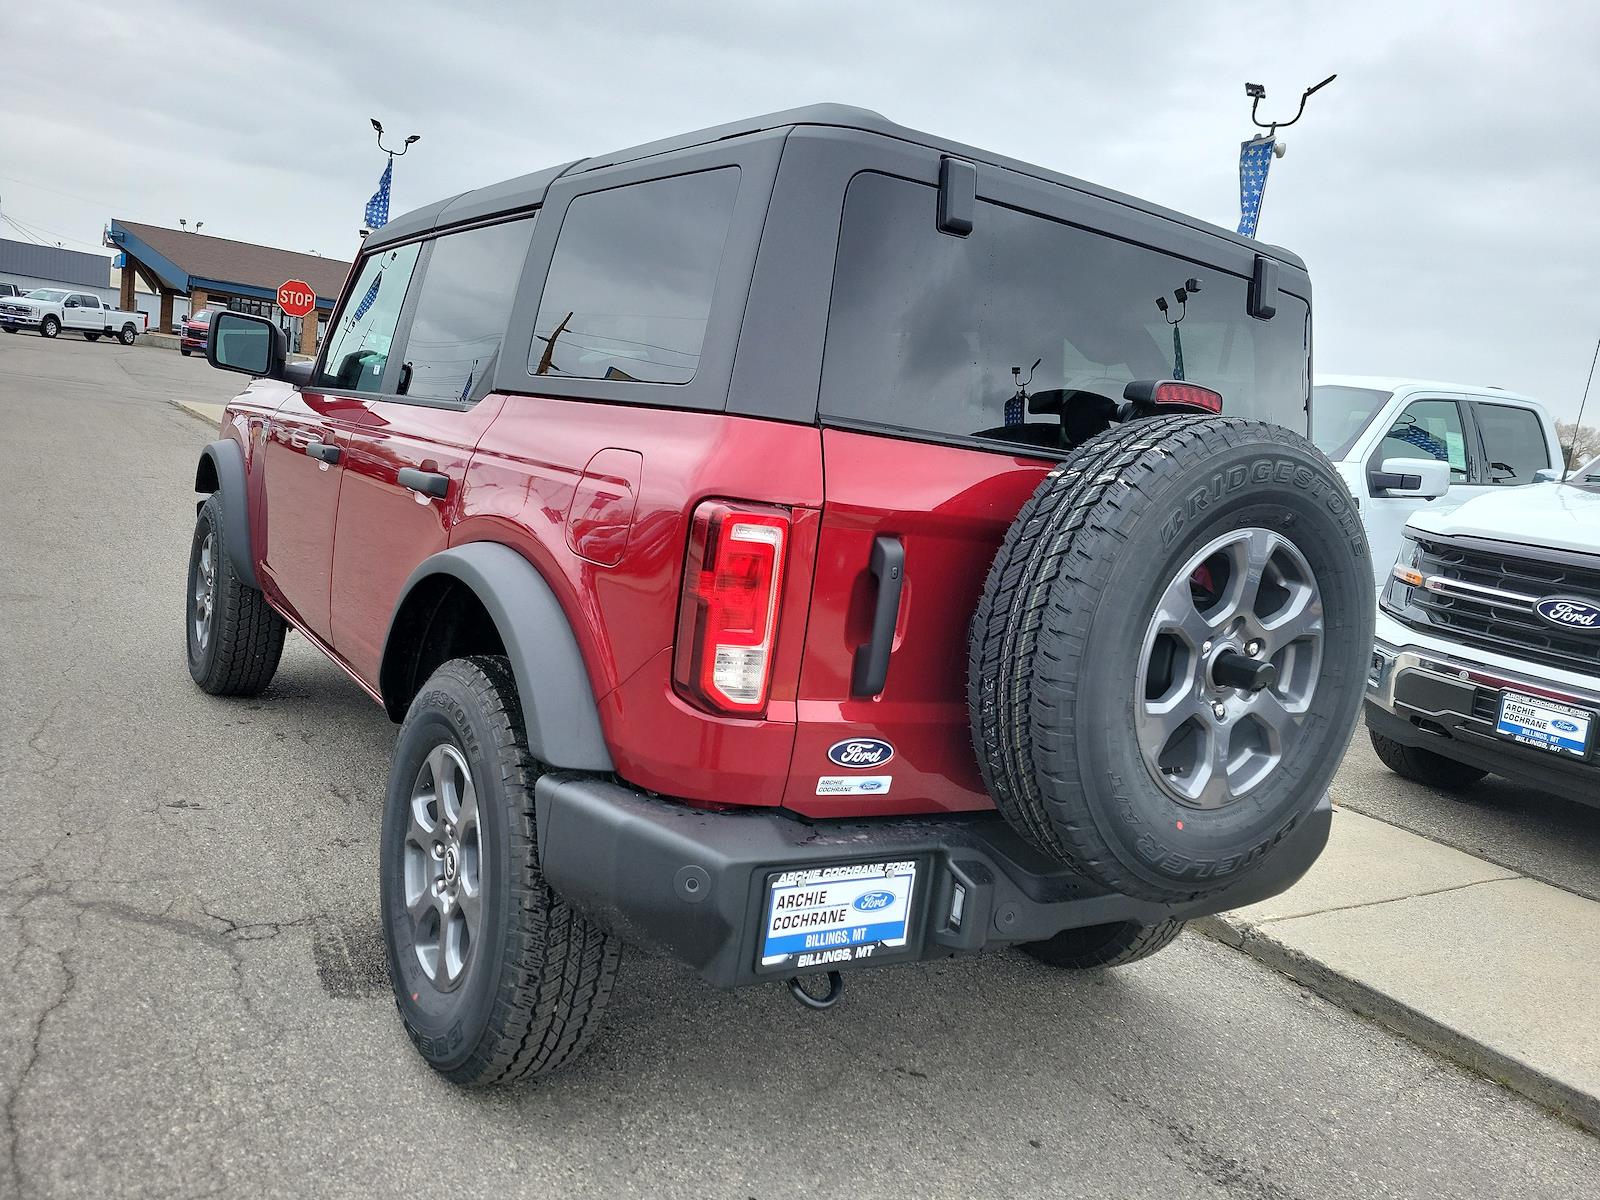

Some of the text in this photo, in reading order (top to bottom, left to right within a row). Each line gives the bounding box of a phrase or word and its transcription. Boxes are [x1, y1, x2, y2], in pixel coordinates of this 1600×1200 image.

[280, 290, 313, 307] STOP
[1160, 459, 1366, 557] BRIDGESTONE
[1549, 602, 1598, 626] Ford
[1505, 703, 1536, 717] ARCHIE
[1506, 692, 1590, 717] ARCHIE COCHRANE FORD
[1503, 712, 1548, 730] COCHRANE
[1515, 735, 1562, 752] BILLINGS, MT
[1521, 728, 1560, 743] BILLINGS, MT
[841, 743, 884, 763] Ford
[776, 861, 916, 884] ARCHIE COCHRANE FORD
[776, 890, 827, 910] ARCHIE
[861, 893, 889, 910] Ford
[773, 909, 847, 931] COCHRANE
[805, 927, 867, 948] BILLINGS, MT
[797, 945, 876, 968] BILLINGS, MT
